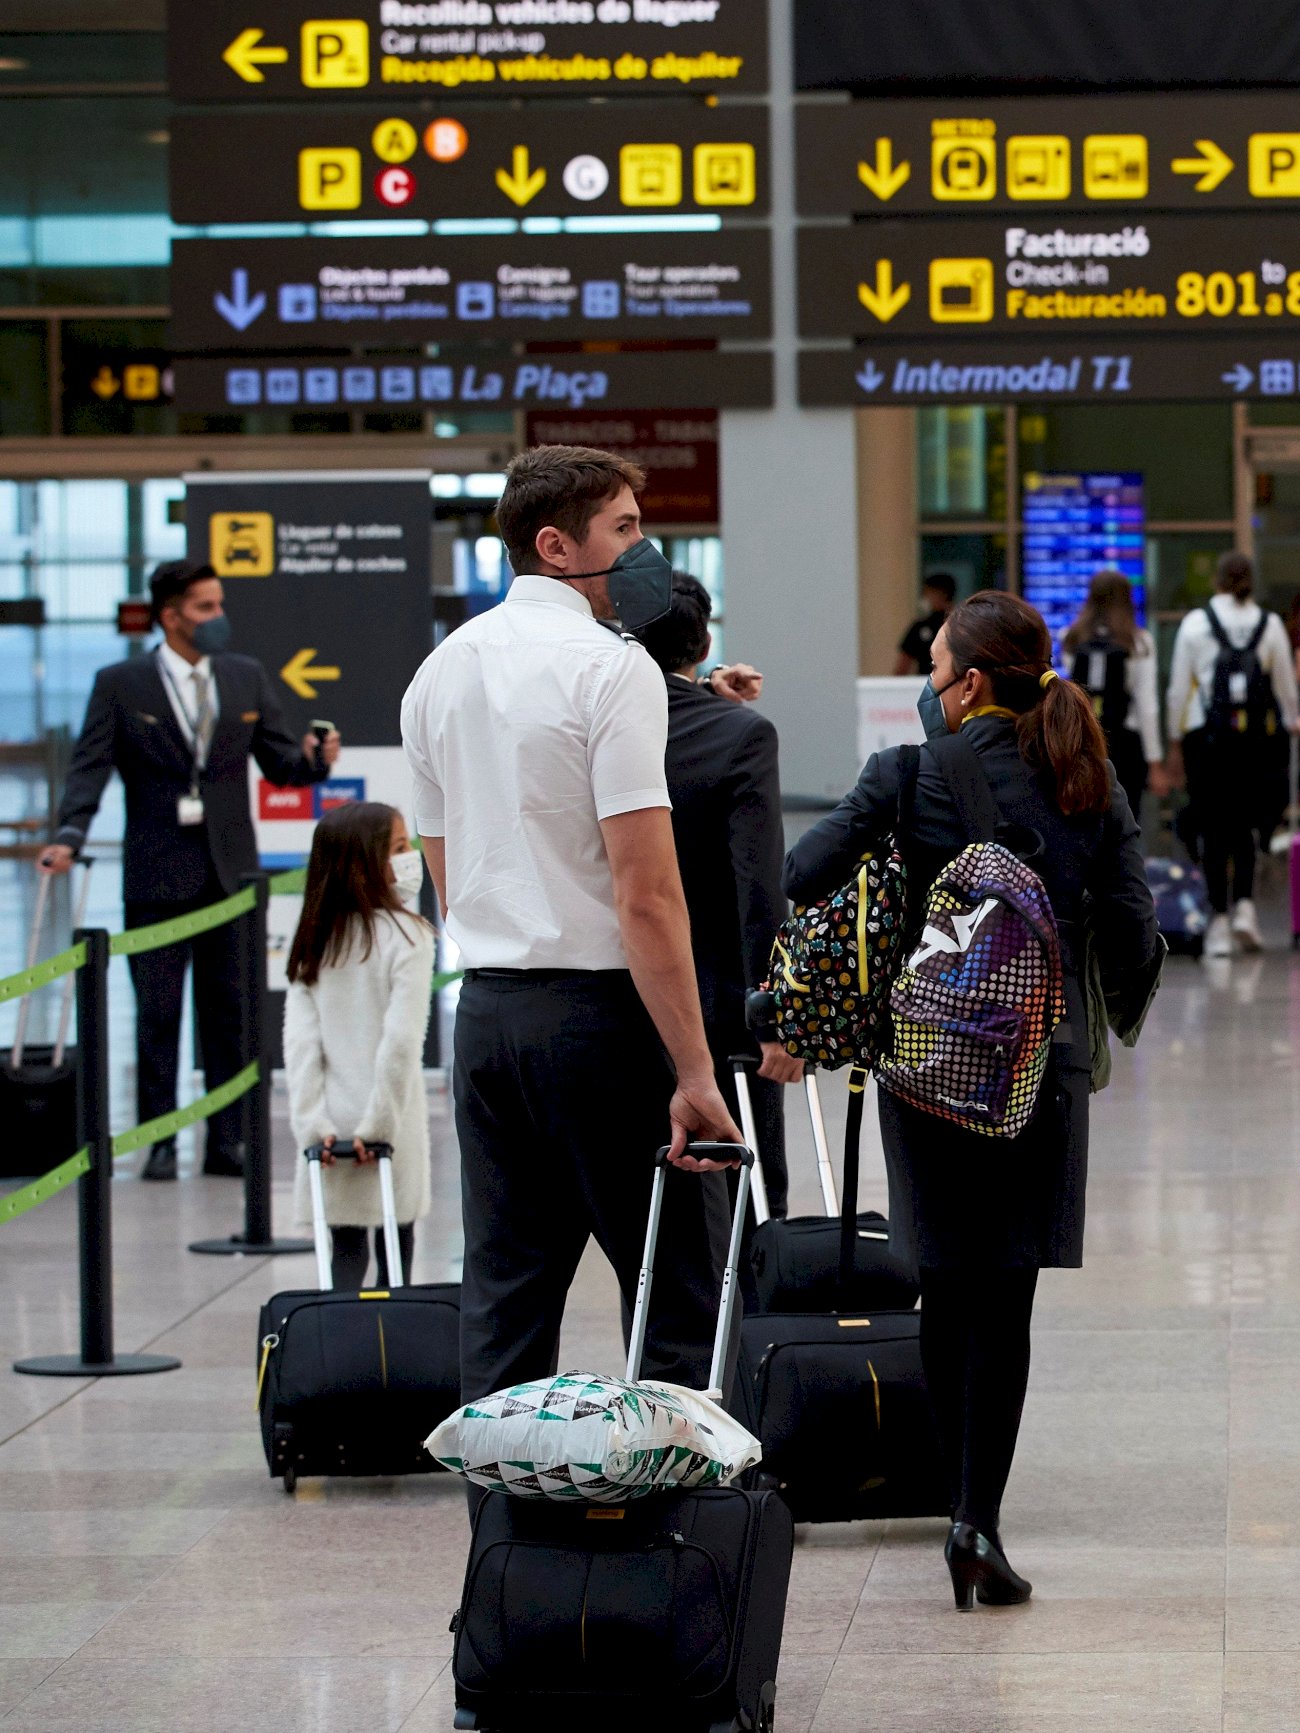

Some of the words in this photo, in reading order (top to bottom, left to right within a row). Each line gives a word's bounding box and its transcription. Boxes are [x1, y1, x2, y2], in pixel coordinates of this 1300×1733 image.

[597, 0, 631, 23] de
[381, 29, 417, 54] Car
[419, 28, 476, 53] rental
[477, 29, 545, 55] pick-up
[381, 56, 495, 86] Recogida
[614, 53, 647, 79] de
[651, 52, 743, 83] alquiler
[386, 128, 404, 152] A
[435, 128, 455, 152] B
[381, 171, 409, 204] C
[575, 161, 597, 190] G
[1005, 226, 1150, 258] Facturació
[625, 263, 661, 283] Tour
[1006, 259, 1110, 287] Check-in
[1261, 258, 1287, 285] to
[1006, 288, 1167, 319] Facturación
[1175, 271, 1261, 317] 801
[1265, 292, 1284, 317] a
[460, 365, 503, 400] La
[513, 363, 609, 407] Plaça
[892, 356, 1082, 393] Intermodal
[1092, 356, 1132, 391] T1
[334, 524, 353, 539] de
[334, 557, 353, 572] de
[937, 1093, 988, 1111] HEAD
